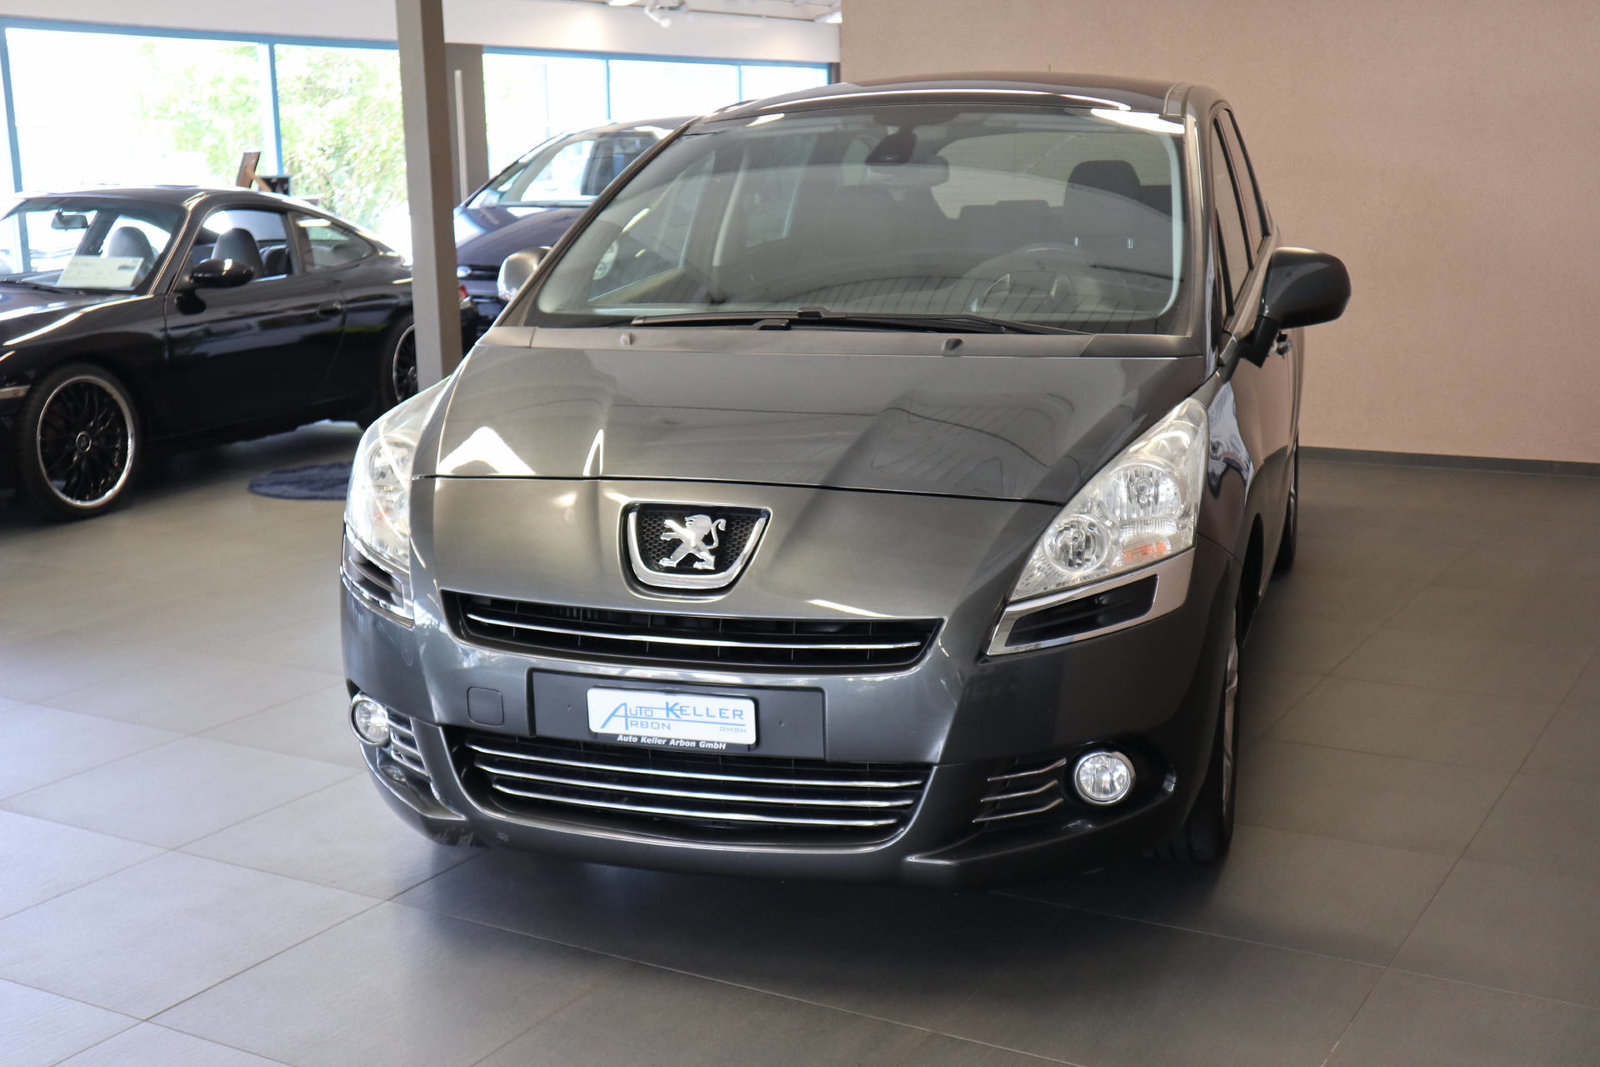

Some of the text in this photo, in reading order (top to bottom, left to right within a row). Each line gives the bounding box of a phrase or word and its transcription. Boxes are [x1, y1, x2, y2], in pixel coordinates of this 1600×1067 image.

[665, 701, 744, 721] KELLER
[617, 734, 727, 750] Auto Keller Arbon GmbH
